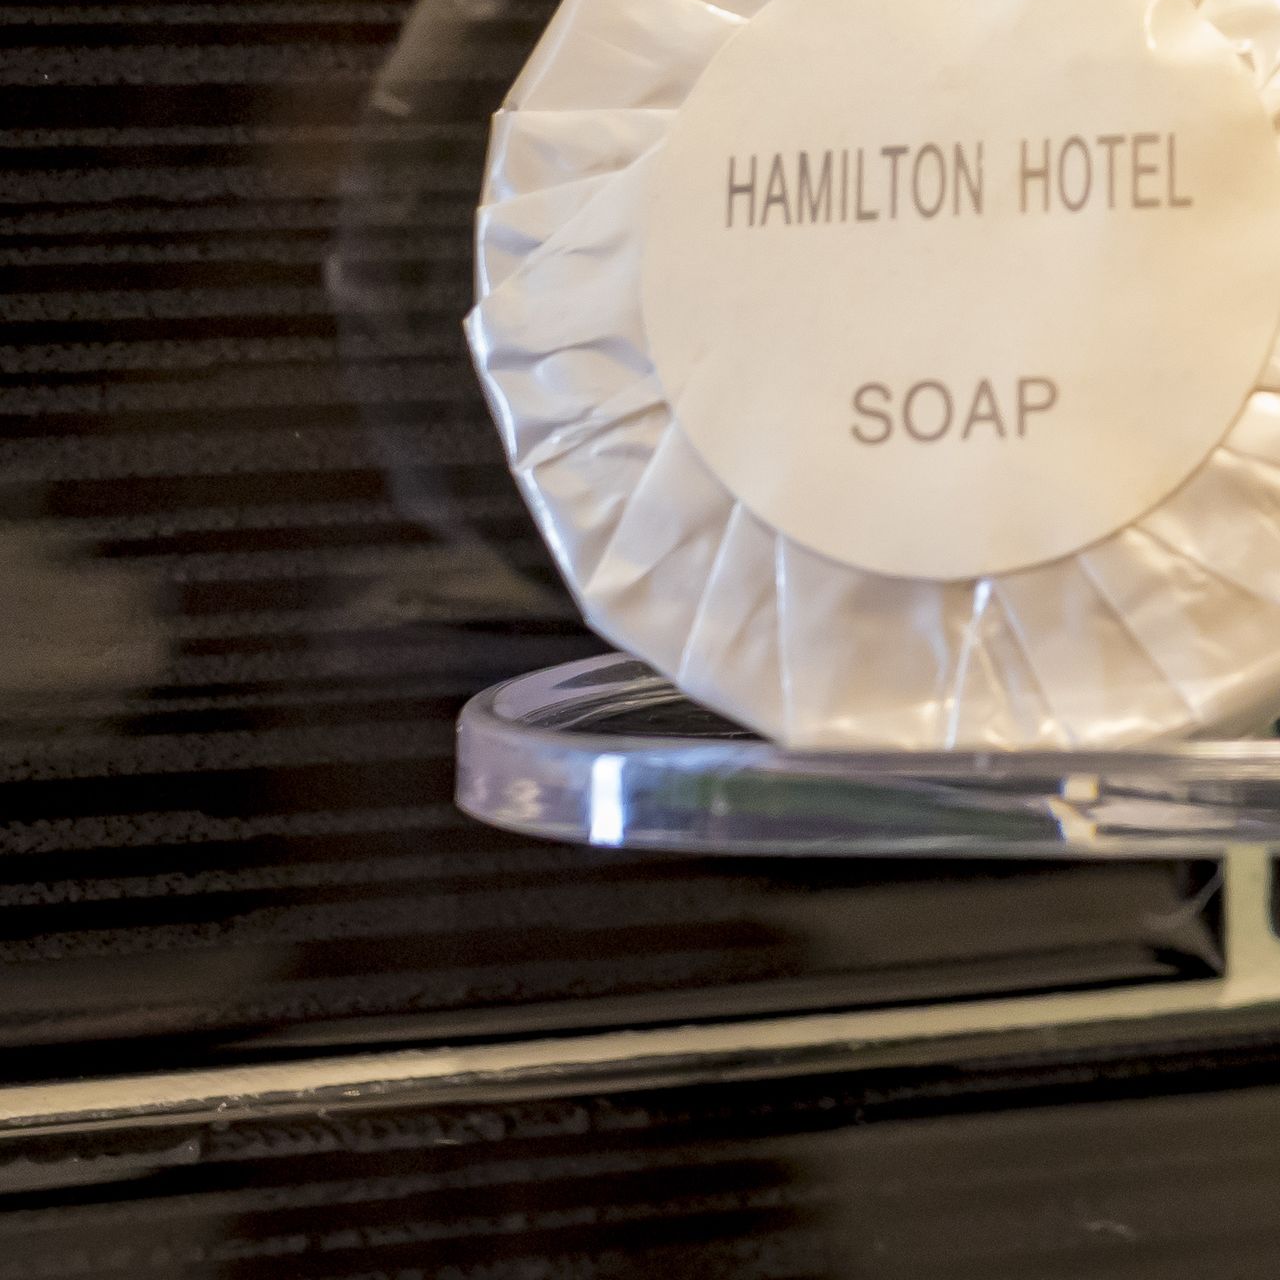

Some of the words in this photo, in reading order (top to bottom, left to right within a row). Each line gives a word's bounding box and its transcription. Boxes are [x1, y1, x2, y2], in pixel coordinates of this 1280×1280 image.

[725, 140, 984, 229] HAMILTON
[1019, 132, 1194, 214] HOTEL
[850, 376, 1059, 447] SOAP
